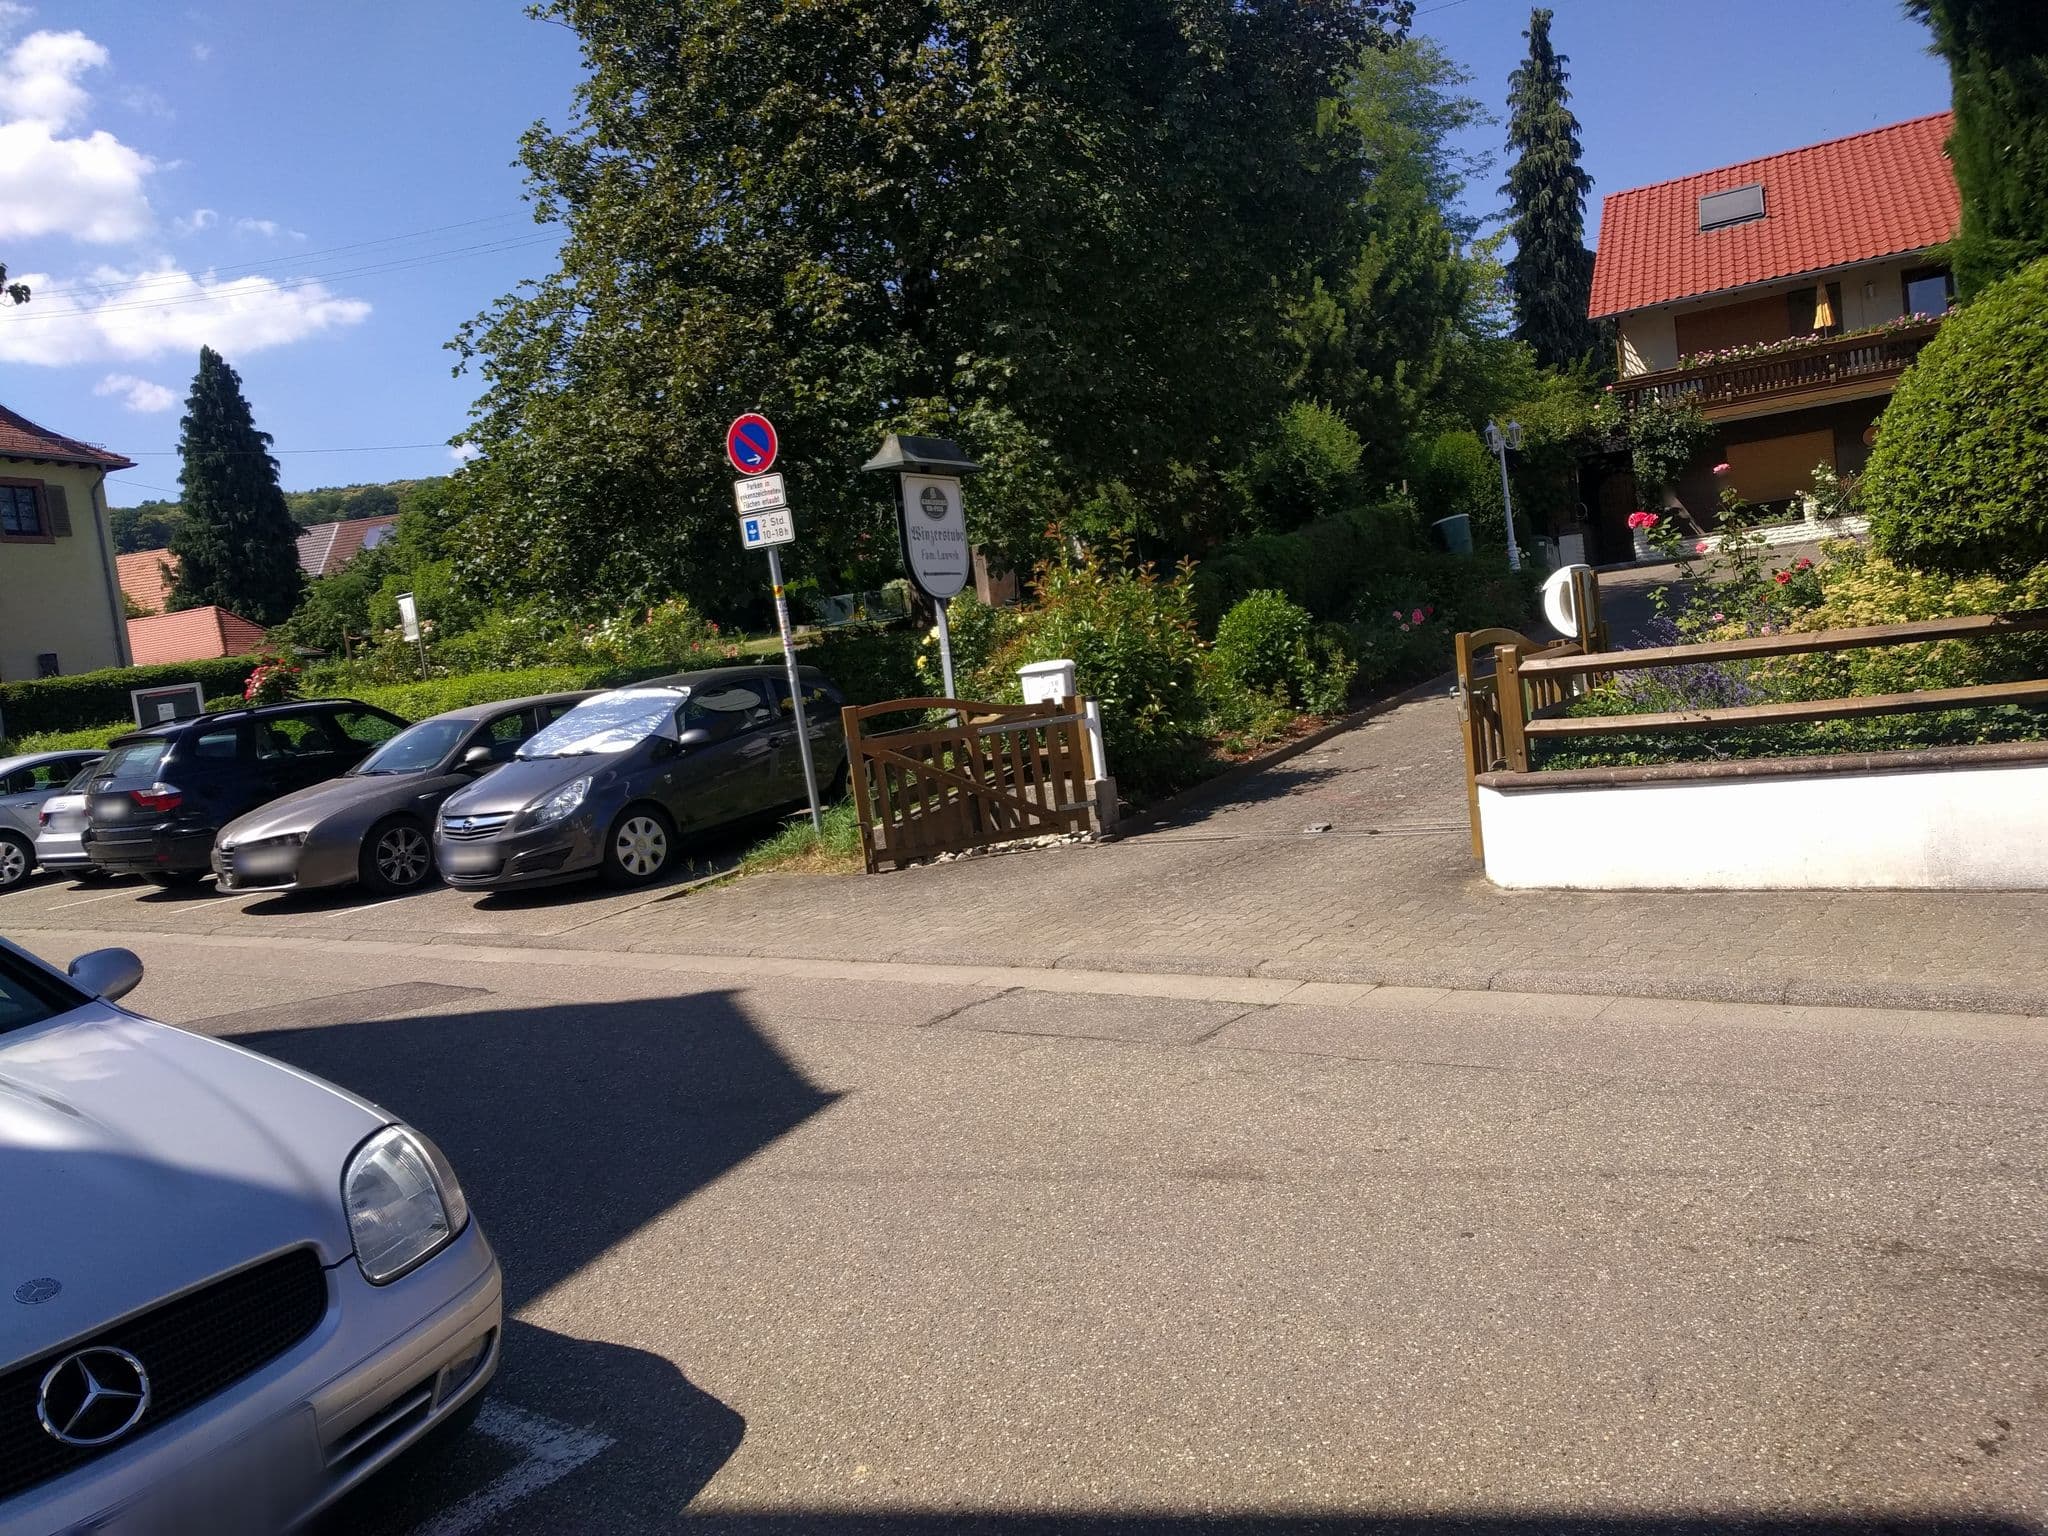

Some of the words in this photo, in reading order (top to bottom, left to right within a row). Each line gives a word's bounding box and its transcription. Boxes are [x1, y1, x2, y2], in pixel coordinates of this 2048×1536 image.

[747, 482, 762, 490] Parken
[762, 519, 767, 528] 2
[911, 526, 964, 545] Winzerstube
